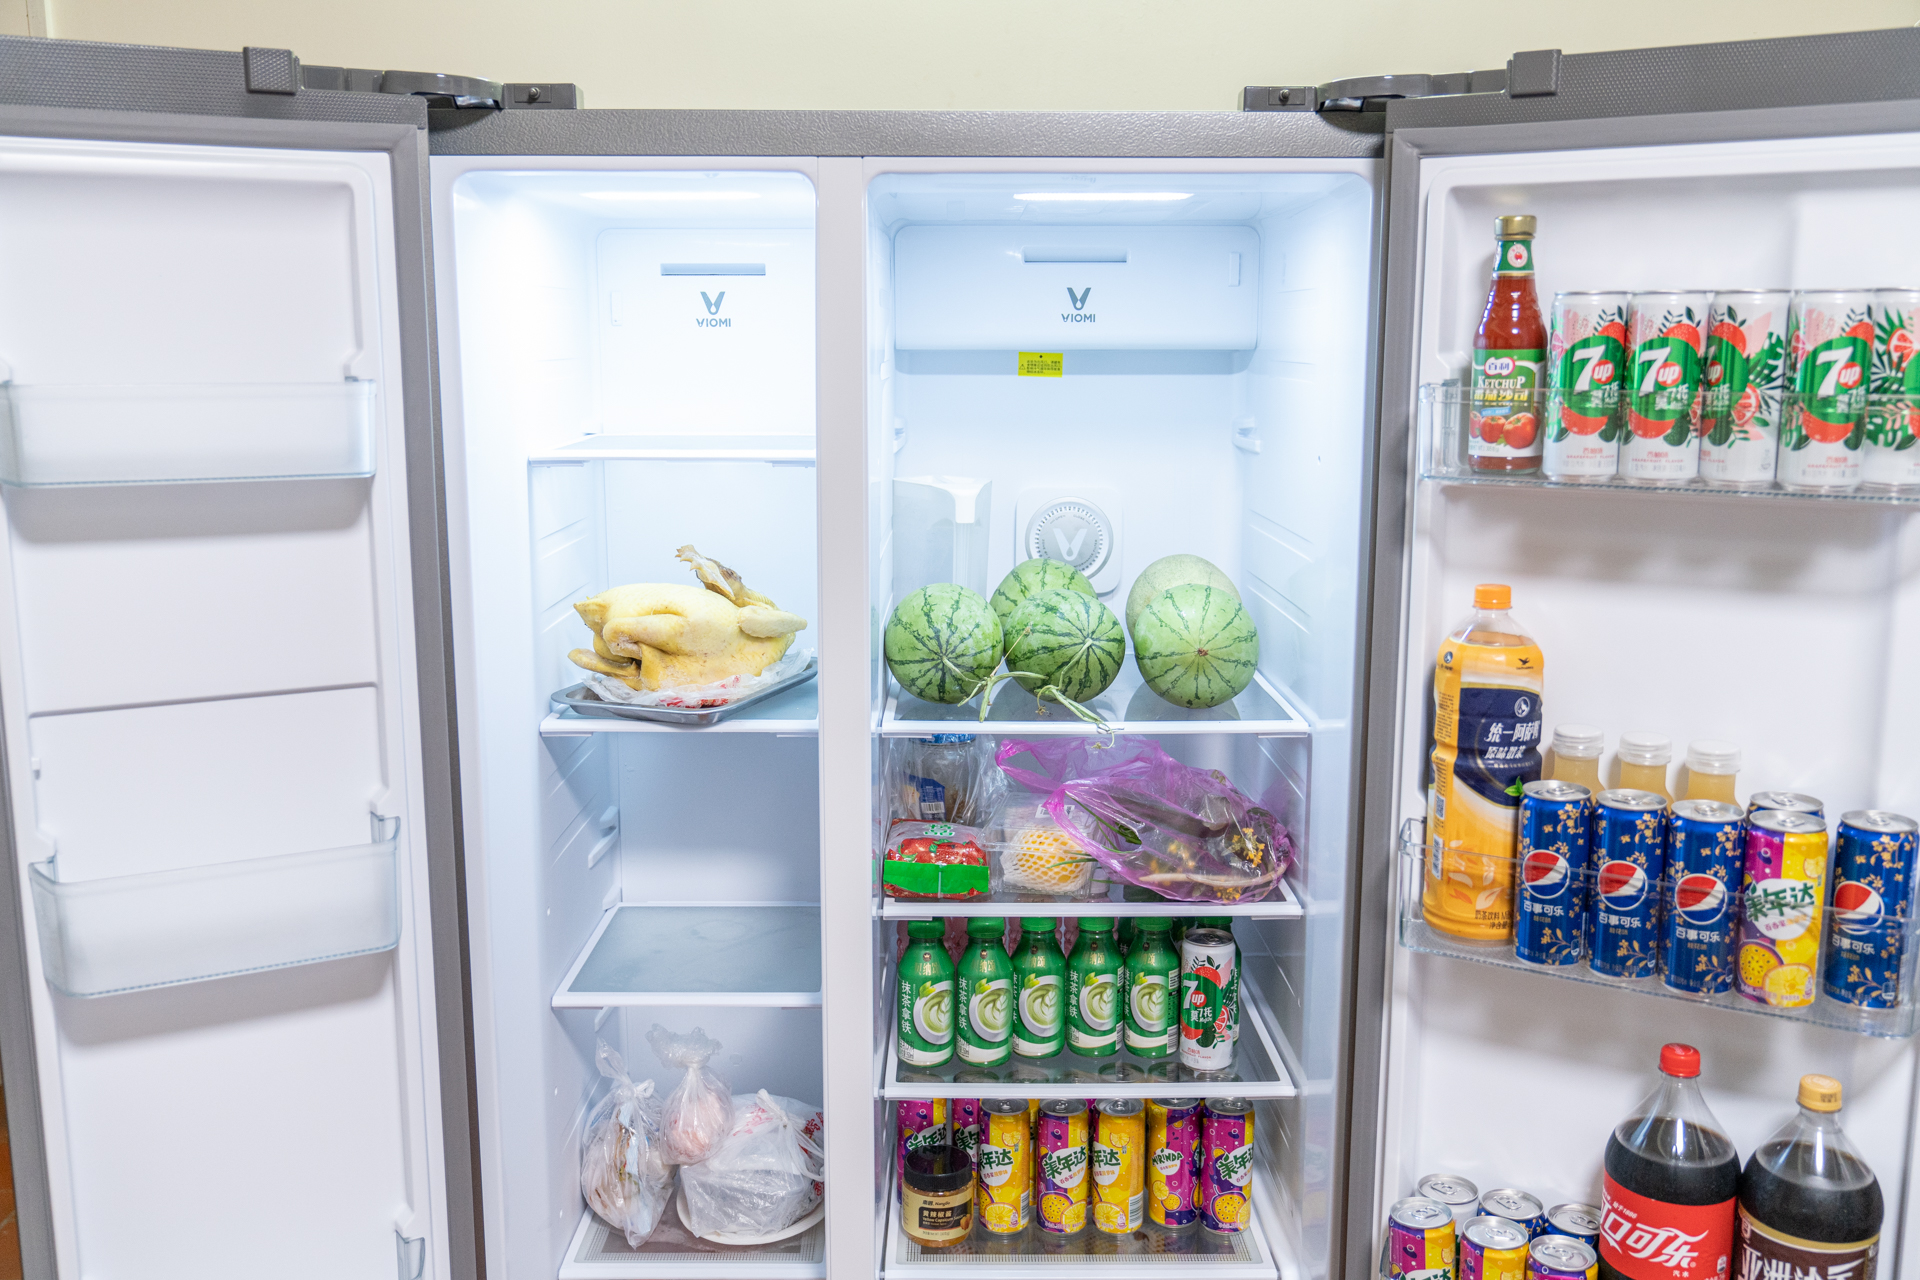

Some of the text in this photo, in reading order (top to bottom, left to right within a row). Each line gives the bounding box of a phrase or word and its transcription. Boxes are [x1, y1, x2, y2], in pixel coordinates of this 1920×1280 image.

[696, 318, 732, 328] VIOMI
[1061, 313, 1096, 323] VIOMI
[1477, 375, 1526, 389] KETCHUP
[901, 980, 912, 1035] 抹茶拿铁
[1042, 1146, 1087, 1180] 美年达
[1093, 1148, 1122, 1168] 年达
